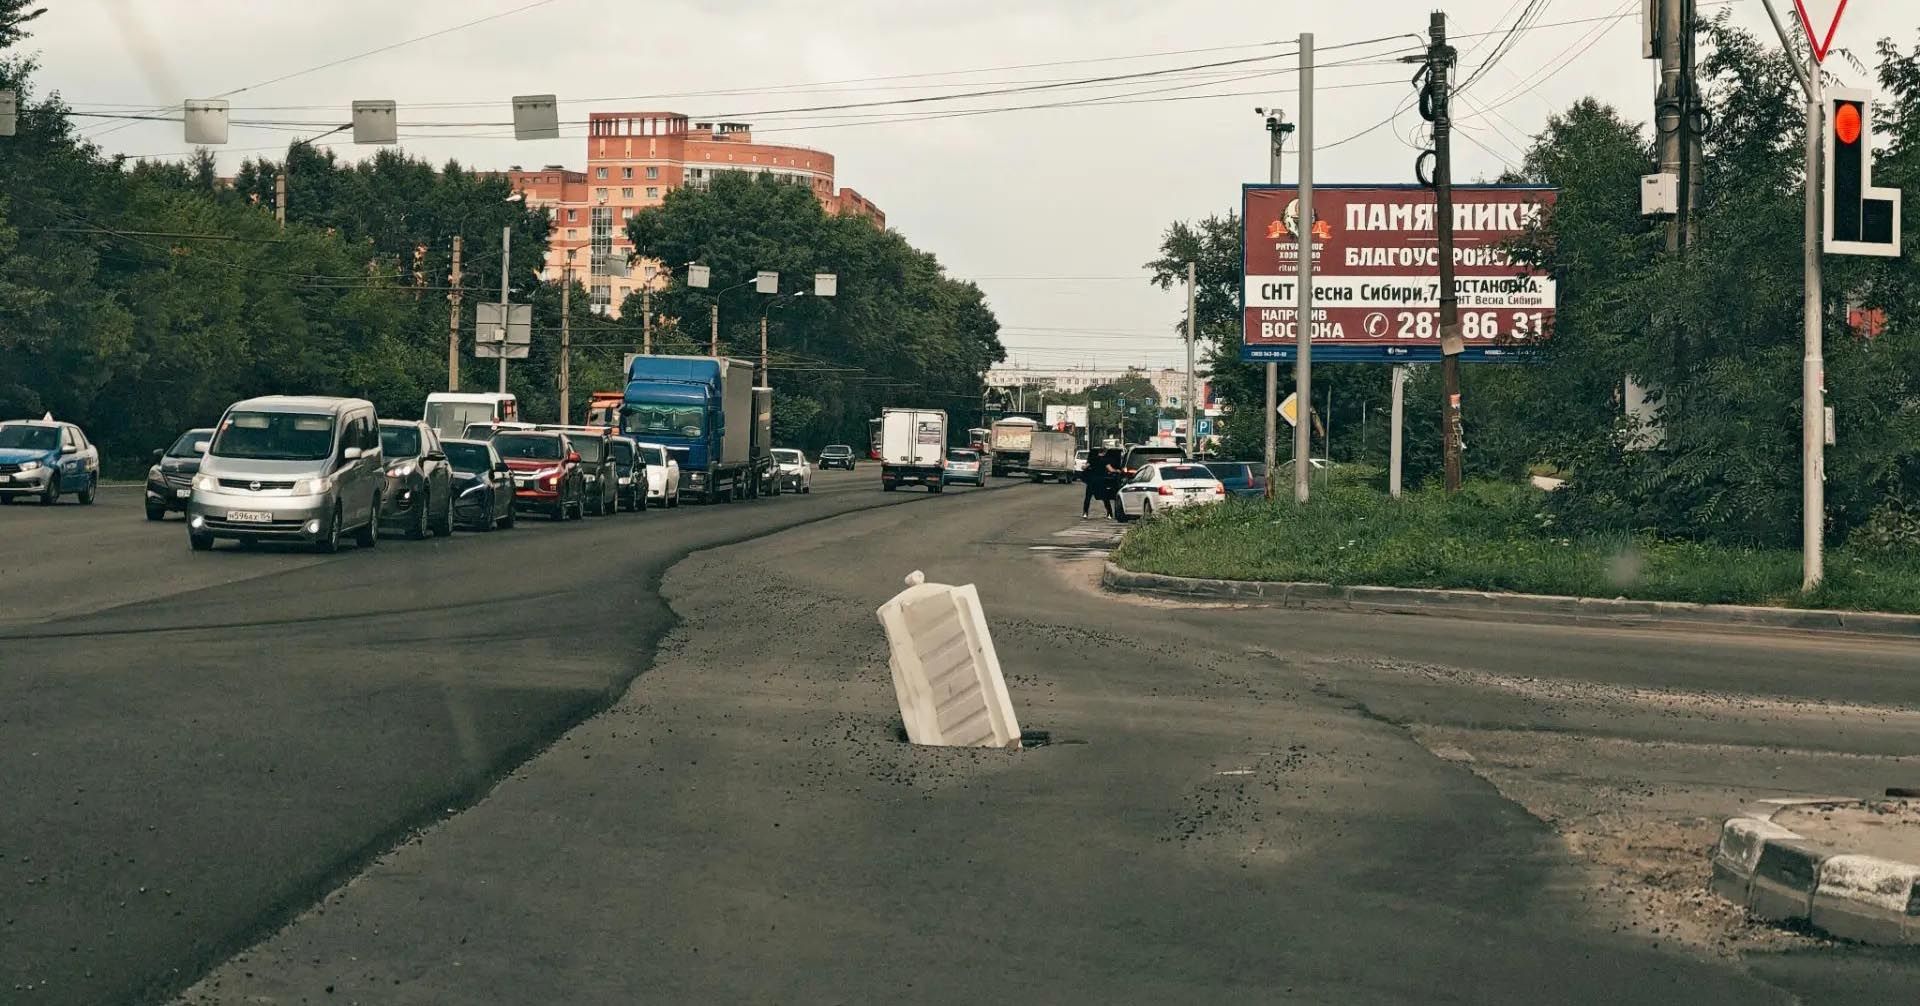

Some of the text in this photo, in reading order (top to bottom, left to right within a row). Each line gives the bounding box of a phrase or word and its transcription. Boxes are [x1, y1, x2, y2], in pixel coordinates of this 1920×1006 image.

[1345, 203, 1542, 231] ПАМЯНИКИ
[1275, 243, 1324, 251] РИТУАОЕ
[1279, 251, 1321, 259] ХОЗЯВО
[1345, 245, 1542, 266] БЛАГОУСРОЙС
[1261, 283, 1295, 300] СНТ
[1308, 283, 1353, 301] есна
[1475, 295, 1504, 305] Весна
[1507, 295, 1542, 306] Сибири
[1261, 309, 1327, 321] НАПРИВ
[1261, 322, 1345, 338] ВОСОКА
[1462, 311, 1498, 339] 86
[1511, 311, 1542, 339] 31
